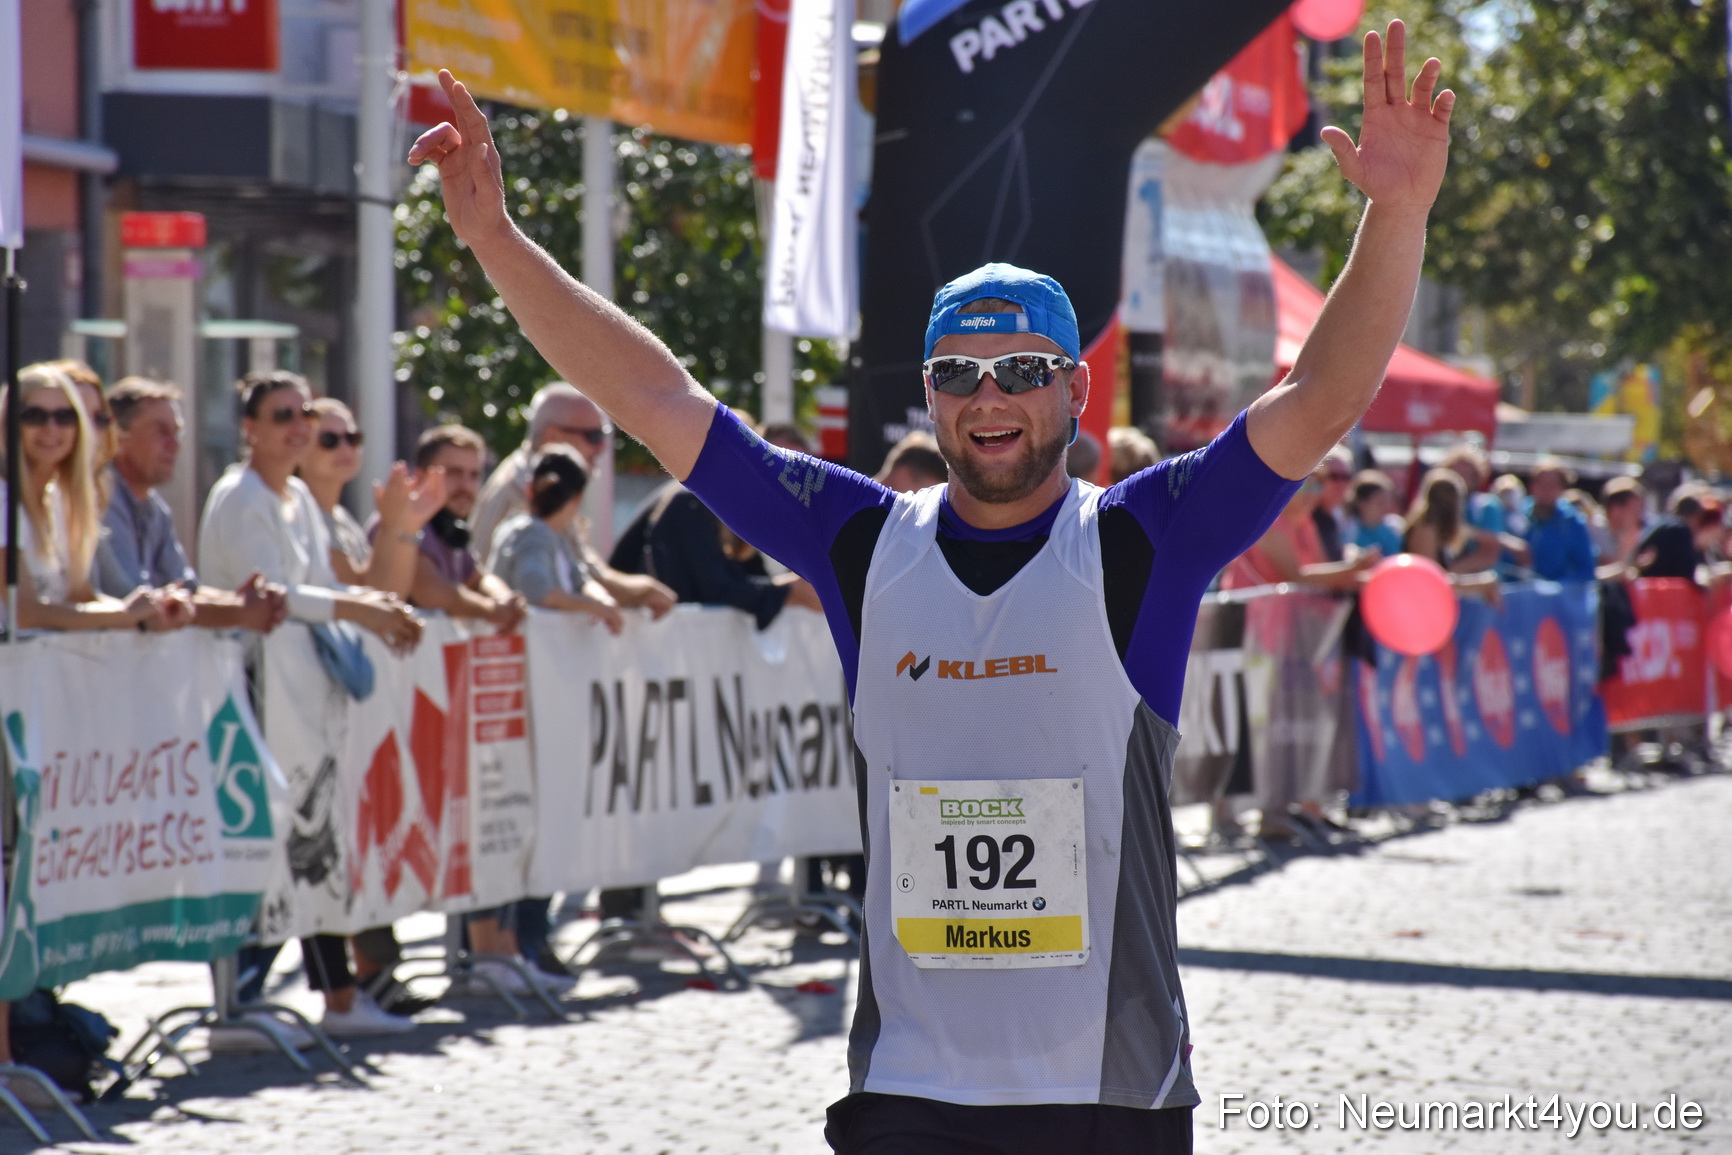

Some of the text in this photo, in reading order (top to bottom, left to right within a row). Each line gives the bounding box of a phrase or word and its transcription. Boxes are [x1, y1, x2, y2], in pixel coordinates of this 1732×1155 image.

[949, 0, 1096, 73] PART
[960, 316, 996, 330] sailfish
[937, 654, 1058, 680] KLEBL
[941, 798, 1025, 818] BOCK
[934, 834, 1037, 891] 192
[902, 878, 909, 889] C
[932, 899, 1028, 911] PARTL Neumarkt
[945, 925, 1032, 948] Markus
